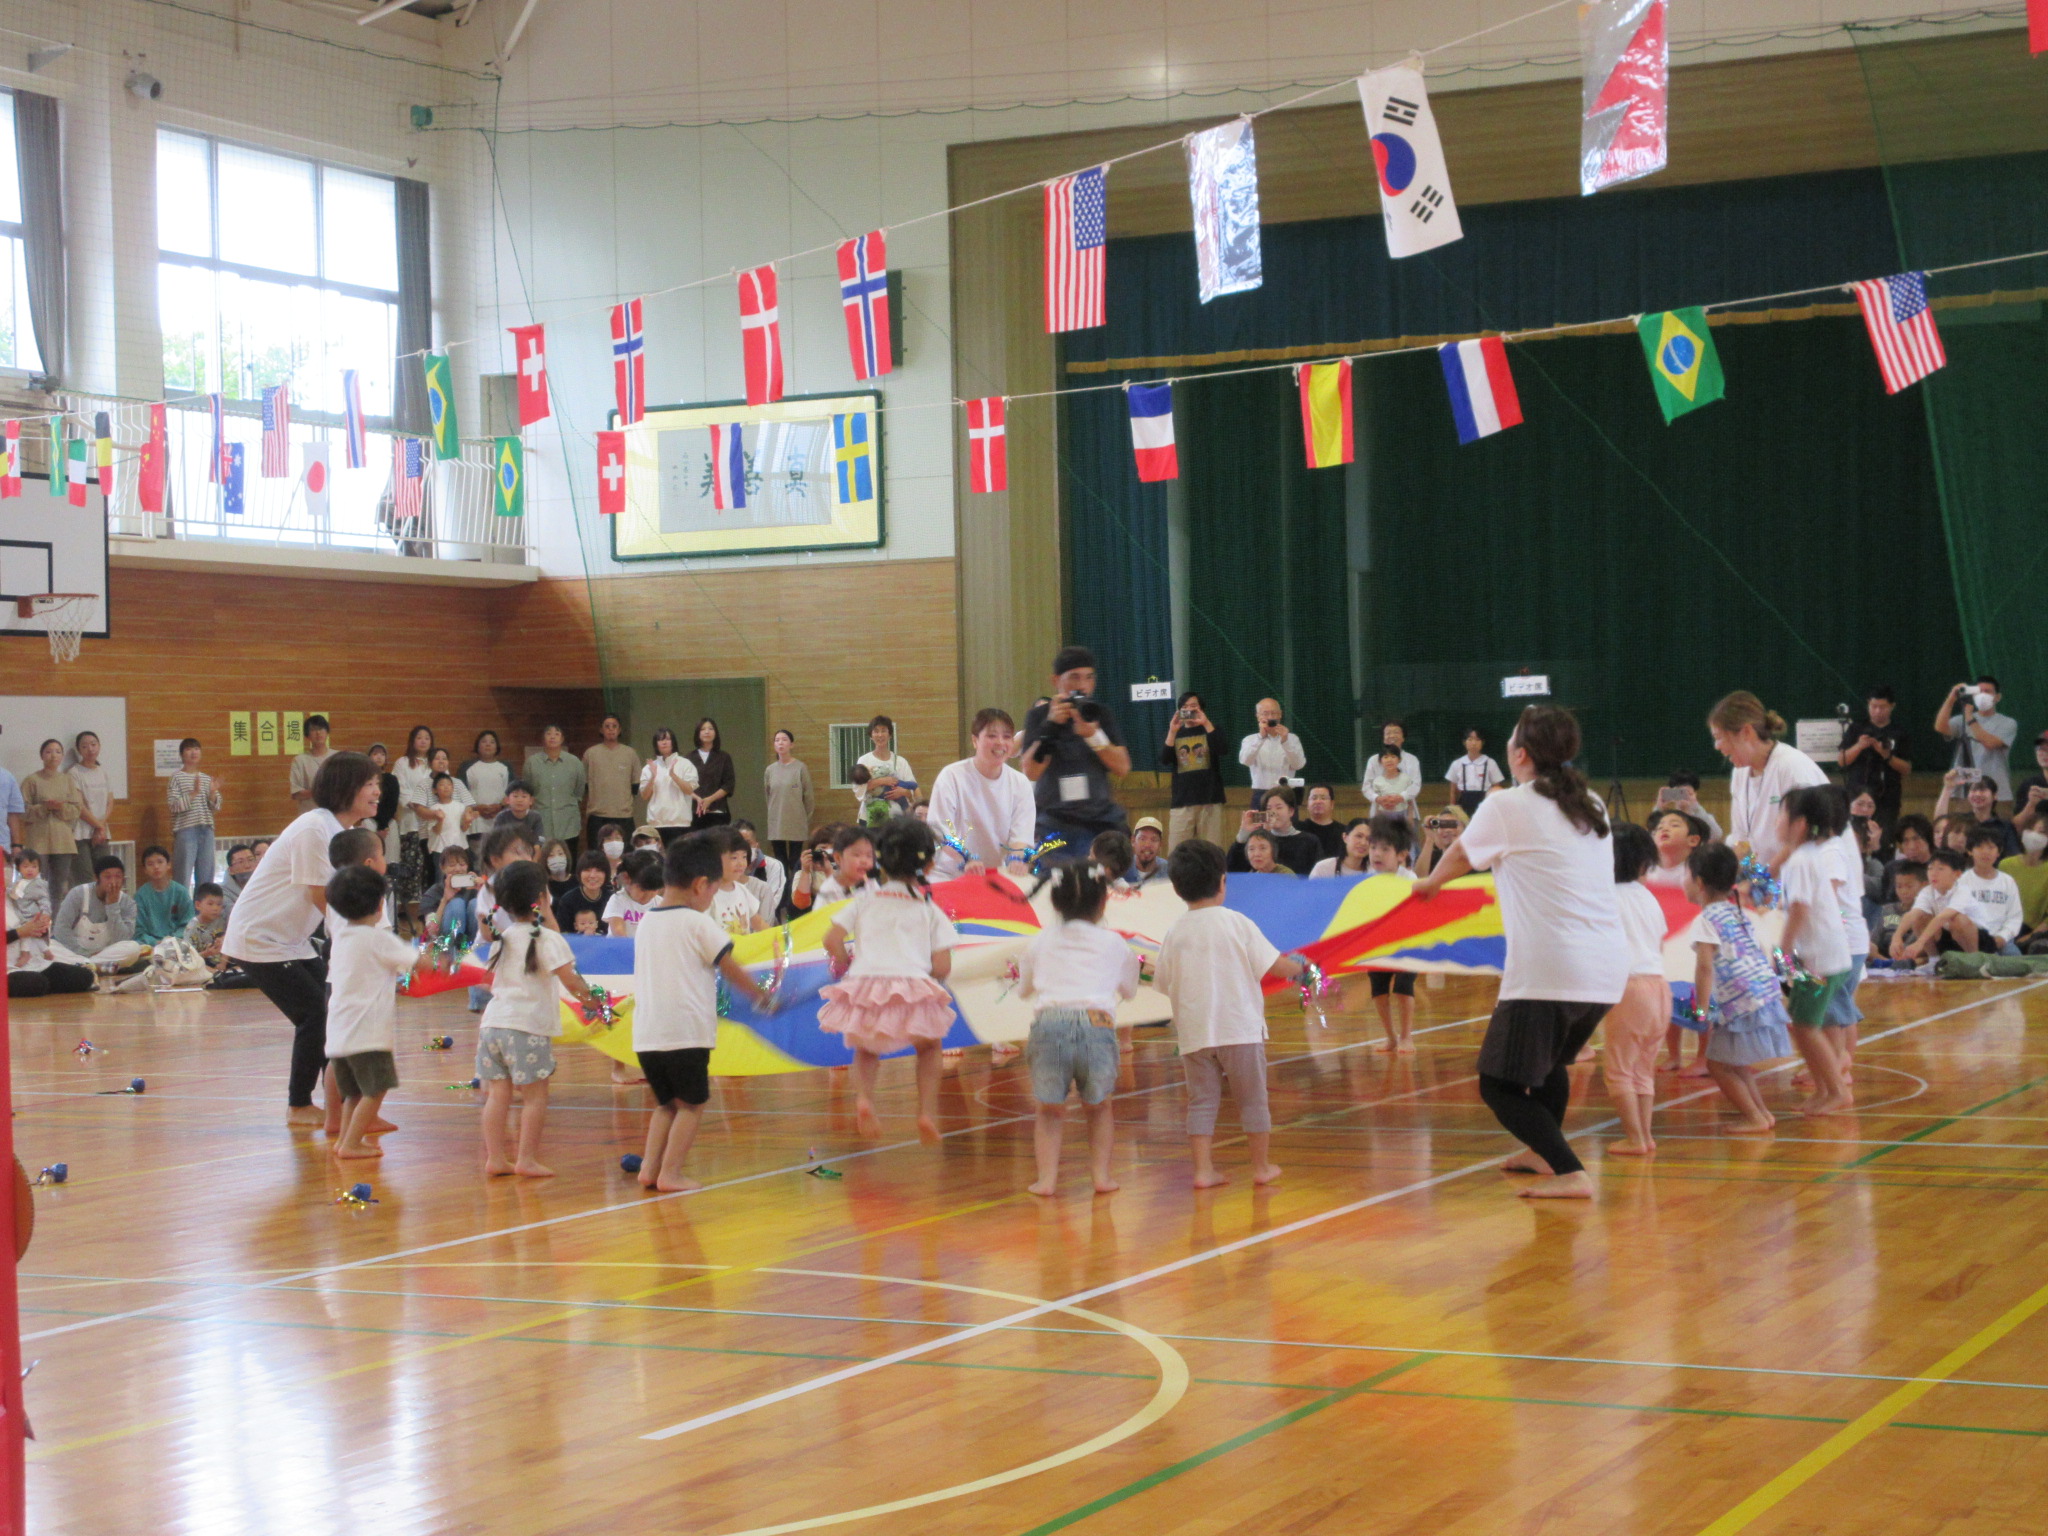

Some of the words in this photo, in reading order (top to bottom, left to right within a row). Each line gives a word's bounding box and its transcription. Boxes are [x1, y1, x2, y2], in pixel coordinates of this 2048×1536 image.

[1136, 688, 1168, 698] ビデオ席
[233, 720, 301, 742] 集合場
